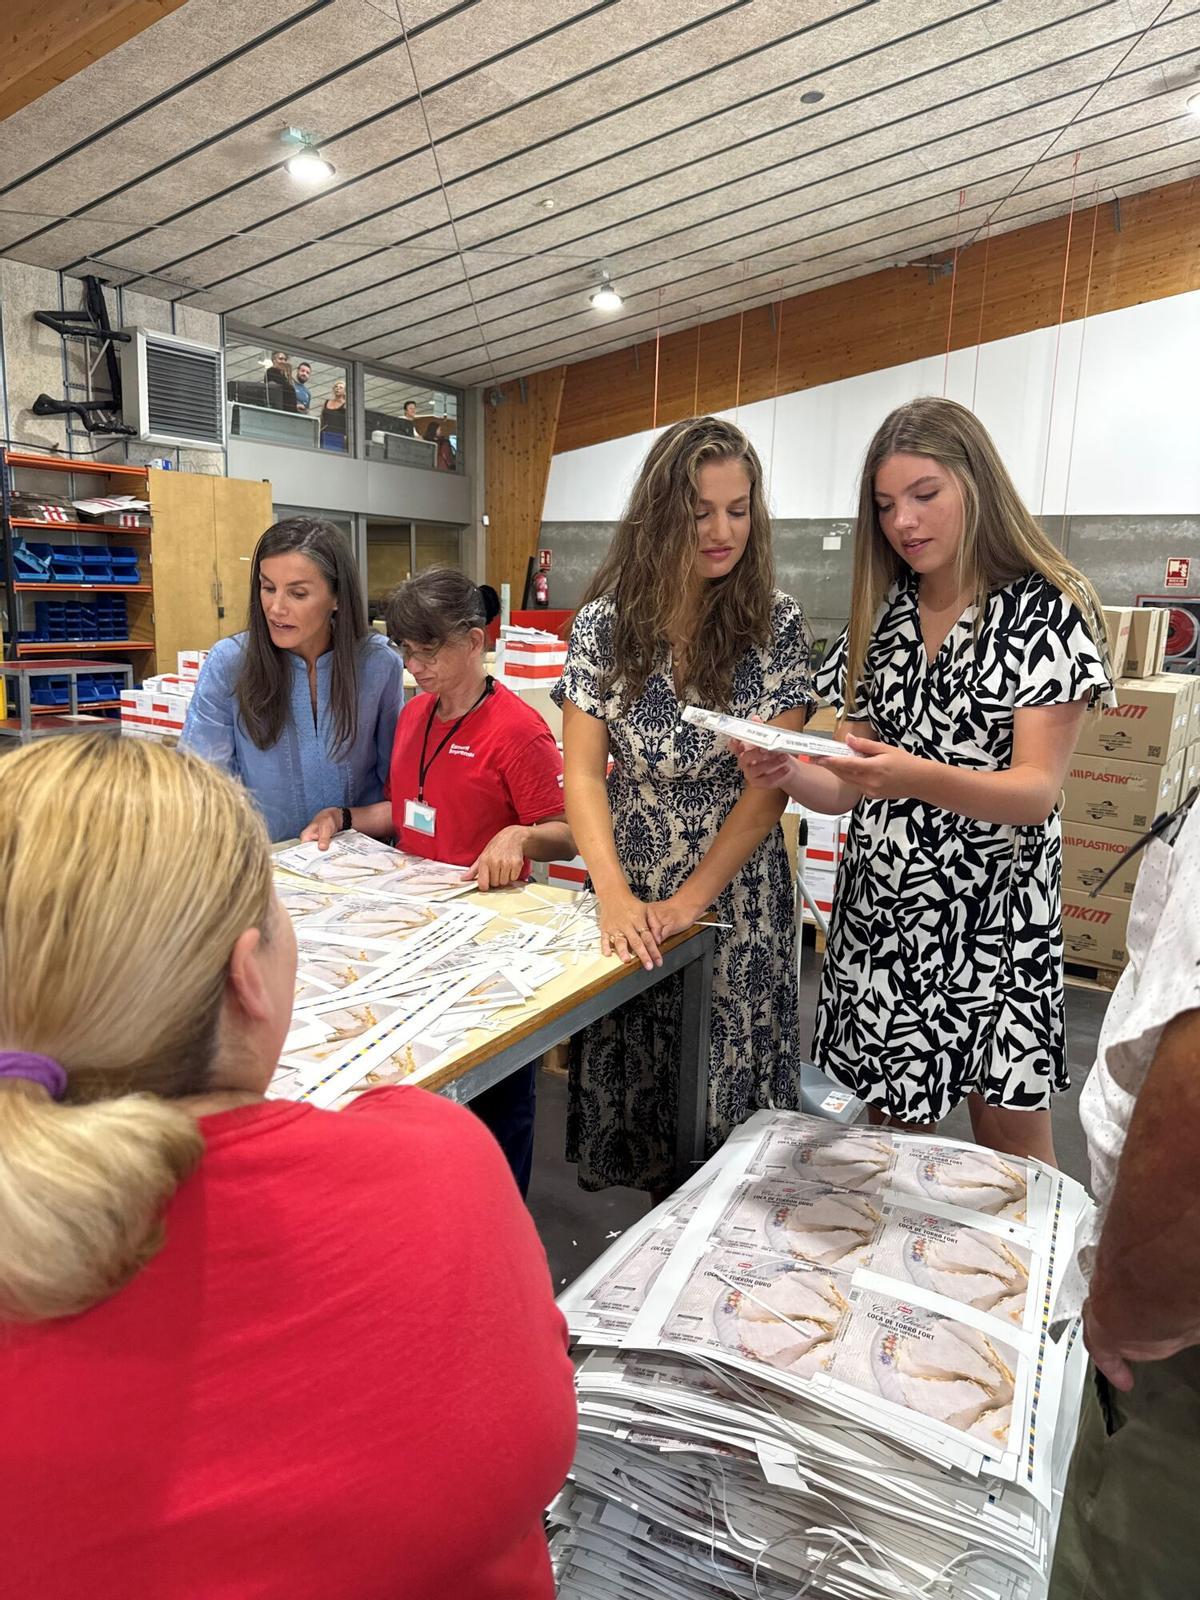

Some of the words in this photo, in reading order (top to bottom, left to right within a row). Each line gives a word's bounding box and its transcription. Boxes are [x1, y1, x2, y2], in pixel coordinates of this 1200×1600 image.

[1084, 770, 1131, 785] PLASTIK
[898, 1222, 913, 1230] COCA
[943, 1235, 959, 1244] FORT
[754, 1280, 773, 1288] DURO
[867, 1312, 883, 1322] COCA
[884, 1318, 894, 1326] DE
[918, 1330, 936, 1341] FORT
